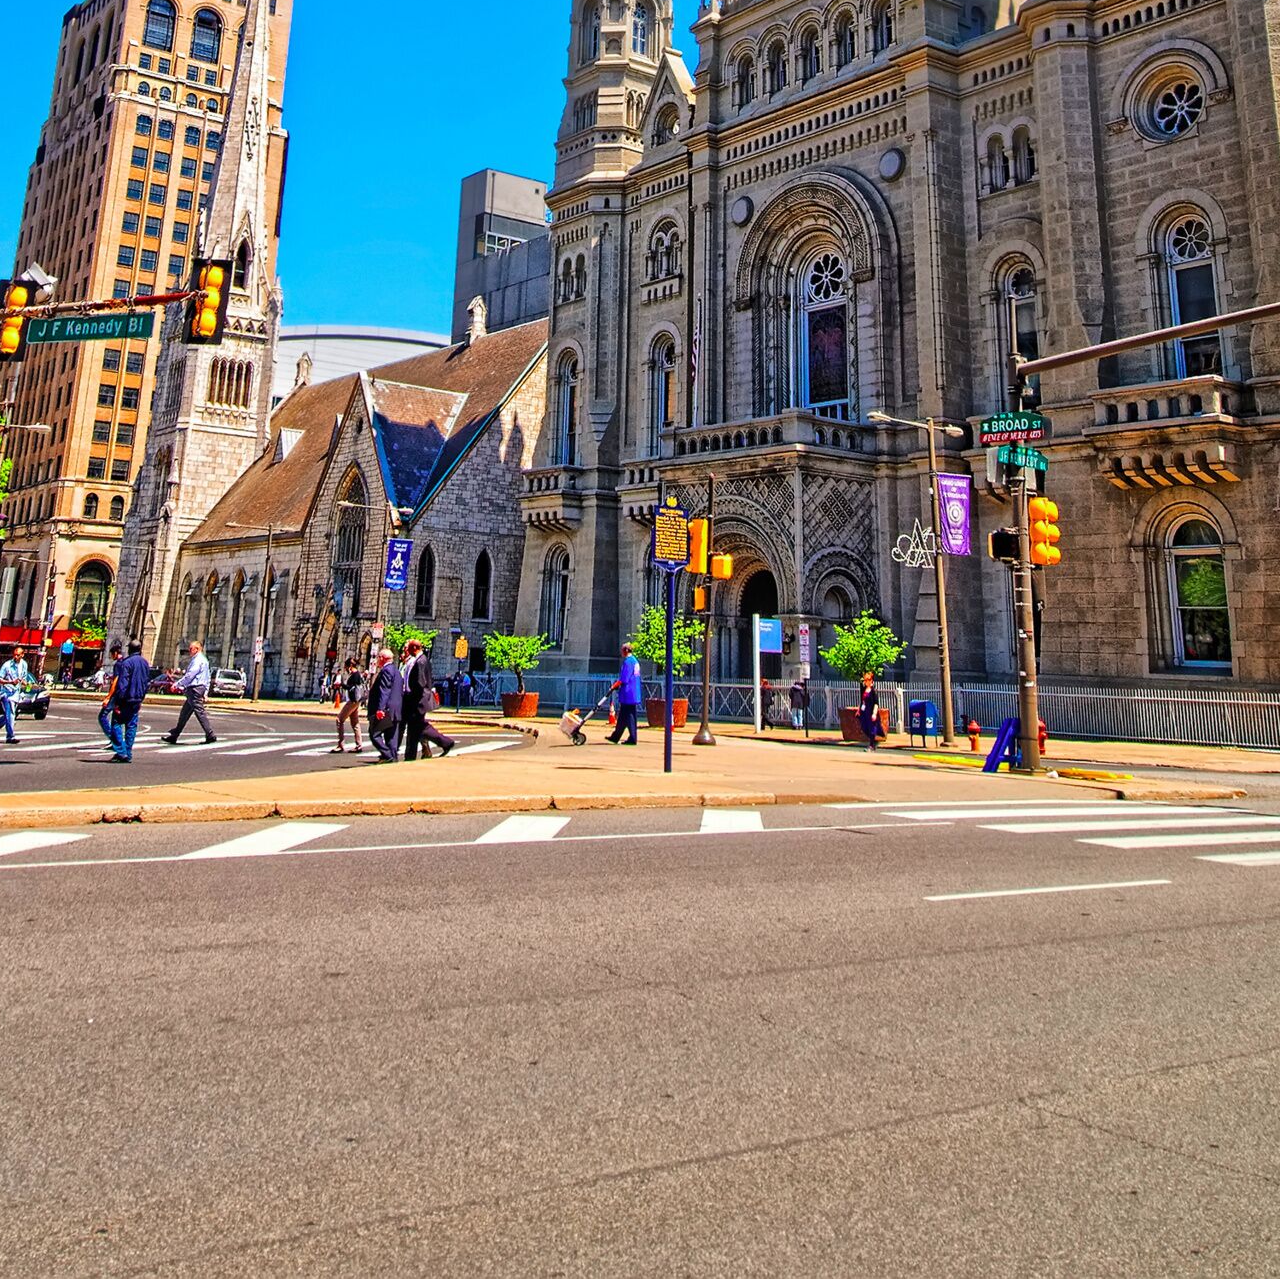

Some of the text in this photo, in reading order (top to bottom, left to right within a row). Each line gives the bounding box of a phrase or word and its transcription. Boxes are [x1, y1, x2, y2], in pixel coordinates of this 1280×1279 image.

[38, 316, 145, 337] J F Kennedy Bl
[991, 418, 1041, 432] BROAD ST
